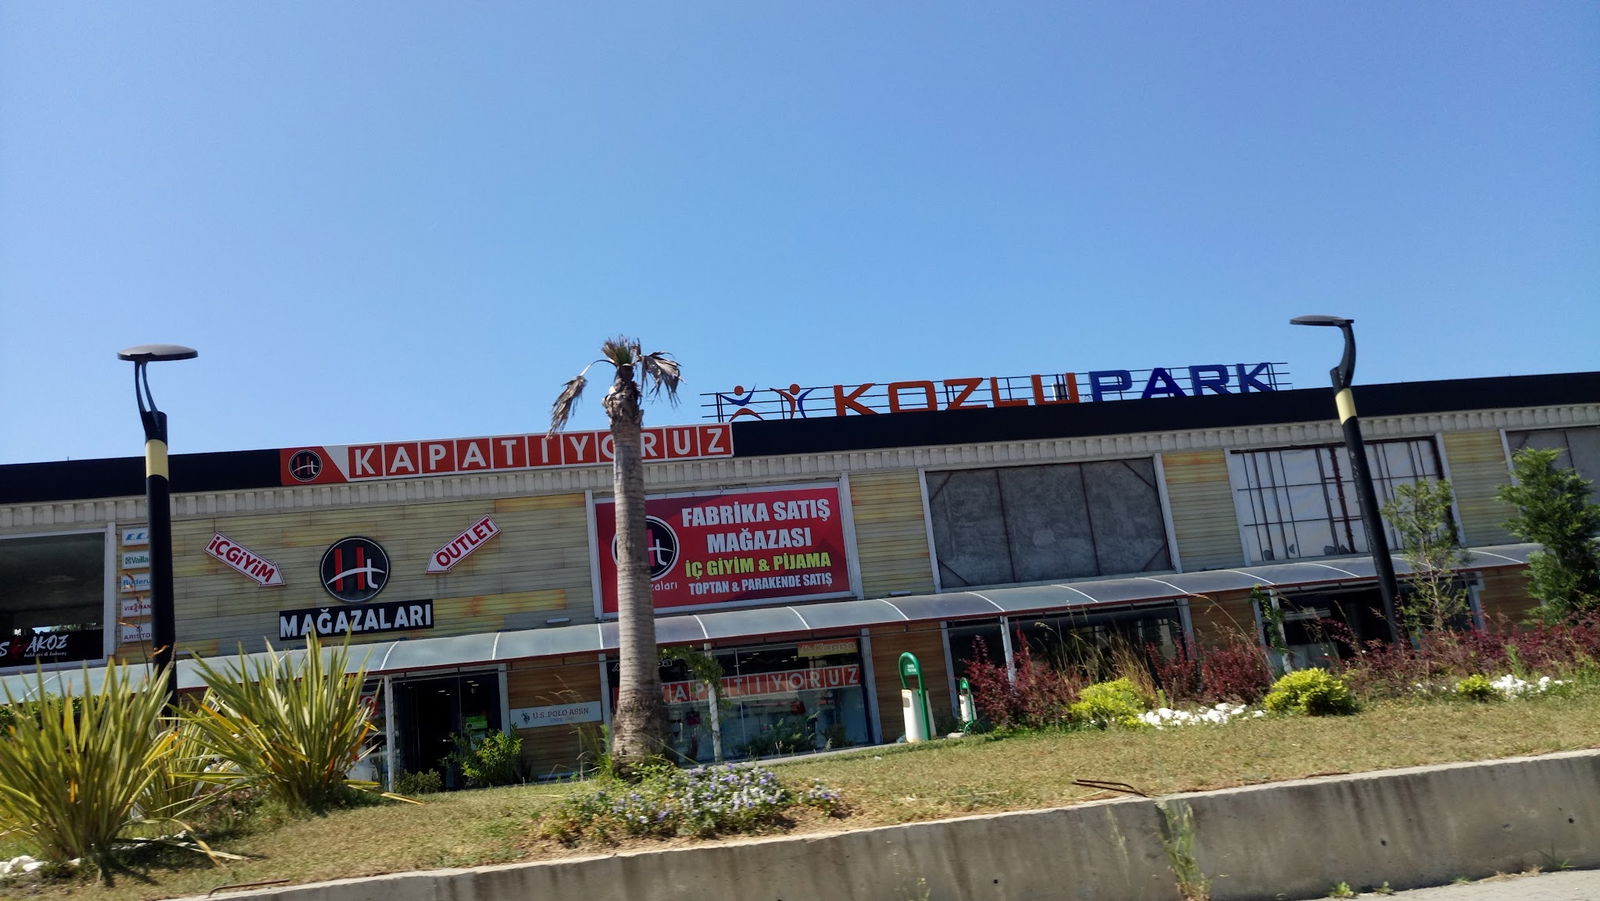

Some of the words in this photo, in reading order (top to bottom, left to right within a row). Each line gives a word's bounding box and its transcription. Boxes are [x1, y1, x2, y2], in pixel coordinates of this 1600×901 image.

[682, 501, 770, 528] FABRİKA
[773, 499, 831, 521] SATIŞ
[436, 518, 494, 567] OUTLET
[707, 527, 812, 554] MAĞAZASI
[685, 560, 703, 579] İÇ
[707, 555, 755, 577] GİYİM
[758, 558, 770, 572] &
[773, 552, 832, 571] PİJAMA
[688, 580, 730, 595] TOPTAN
[732, 581, 740, 592] &
[742, 576, 801, 591] PARAKENDE
[803, 572, 833, 587] SATIŞ
[280, 604, 431, 638] MAĞAZALARI
[26, 635, 69, 653] AKOZ
[662, 668, 858, 703] APTIYORUZ
[547, 708, 568, 718] POLO
